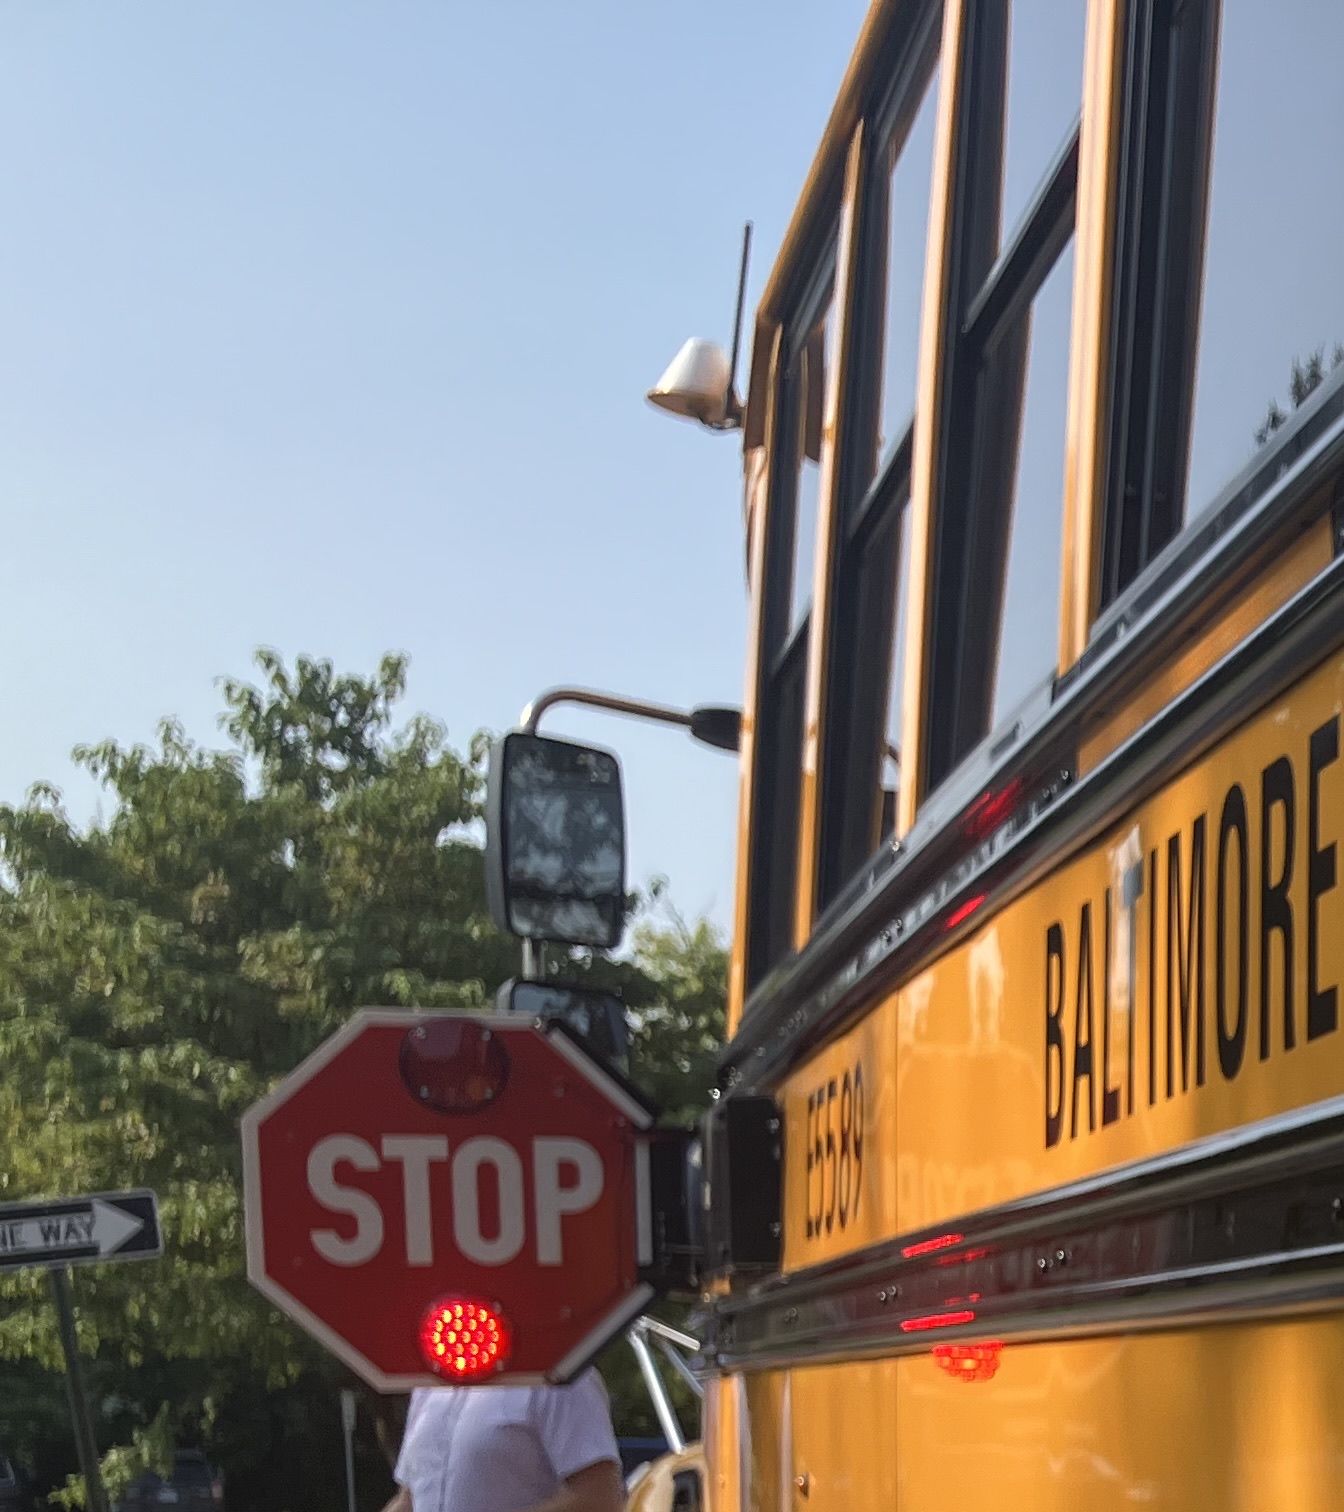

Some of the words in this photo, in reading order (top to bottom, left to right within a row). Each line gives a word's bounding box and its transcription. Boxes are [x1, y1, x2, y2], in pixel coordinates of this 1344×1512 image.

[1043, 713, 1342, 1150] BALTIMORE
[39, 1215, 96, 1248] WAY
[306, 1133, 606, 1268] STOP
